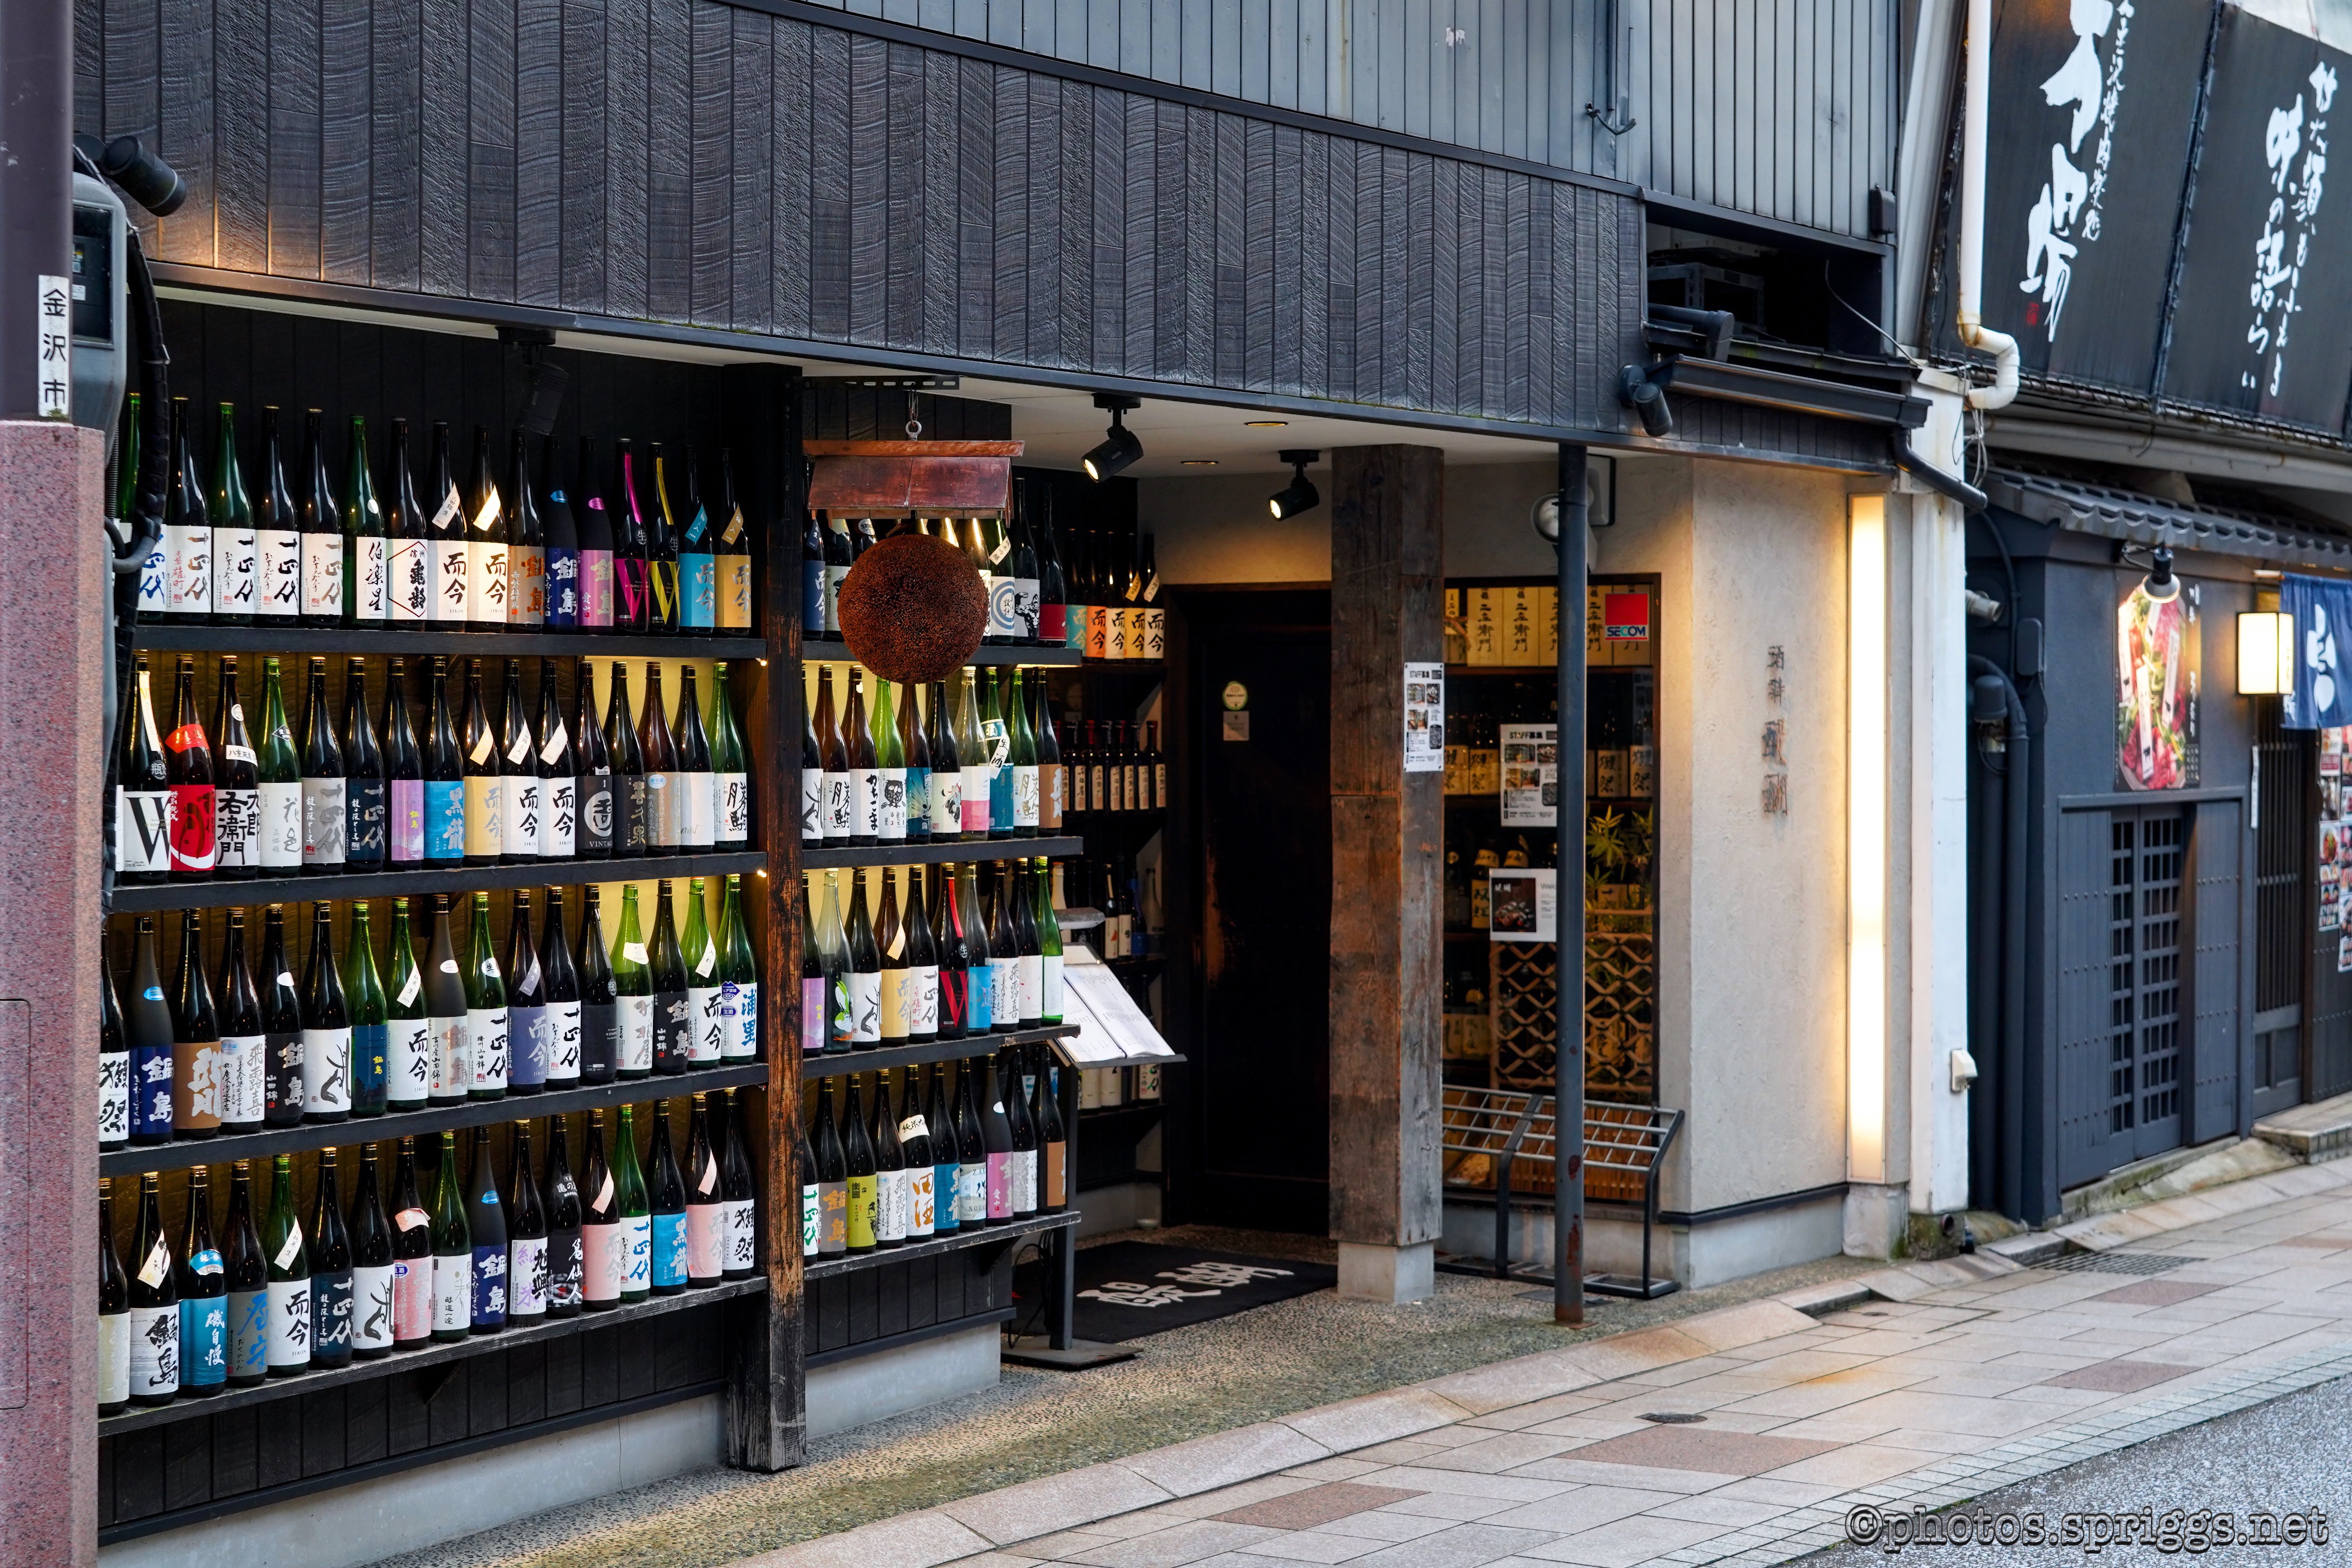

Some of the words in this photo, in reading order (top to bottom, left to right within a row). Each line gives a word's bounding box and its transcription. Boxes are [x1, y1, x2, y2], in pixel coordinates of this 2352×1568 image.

[43, 288, 67, 406] 金沢市
[409, 549, 426, 559] 信州
[637, 530, 646, 542] 生
[138, 534, 165, 600] 四代
[185, 534, 211, 607] 十四代
[234, 534, 255, 607] 十四代
[274, 535, 299, 609] 十四代
[321, 540, 343, 606] 十四代
[367, 540, 384, 612] 伯楽星
[443, 552, 466, 605] 而今
[485, 552, 506, 605] 而今
[521, 554, 544, 615] 鍋島
[551, 556, 578, 617] 鍋島
[591, 558, 612, 617] 鍋島
[614, 558, 650, 623] W
[649, 561, 680, 624] W
[696, 562, 714, 612] 而今
[732, 564, 751, 612] 而今
[1072, 608, 1086, 651] 而今
[1090, 609, 1106, 650] 而今
[1111, 610, 1125, 650] 而今
[1131, 612, 1145, 651] 而今
[1147, 613, 1164, 651] 而今
[1607, 626, 1646, 637] SECOM
[991, 738, 1009, 768] 生酒
[246, 791, 260, 851] 九郎
[284, 797, 301, 853] 花邑
[316, 784, 345, 857] 十四代
[362, 784, 385, 852] 十四代
[443, 786, 464, 850] 黒龍
[483, 786, 500, 839] 而今
[519, 786, 538, 838] 而今
[552, 786, 574, 838] 而今
[727, 781, 748, 833] 勝駒
[831, 781, 850, 829] 勝駒
[866, 773, 879, 831] かちこま
[1019, 773, 1039, 820] 勝駒
[125, 797, 170, 866] W
[217, 791, 249, 865] 右衛門
[959, 945, 968, 954] 生
[741, 988, 756, 1046] 浦里
[896, 977, 910, 1021] 而今
[921, 969, 938, 1025] 十四代
[939, 970, 968, 1029] W
[1009, 963, 1019, 1019] 飛露喜
[487, 1014, 507, 1077] 十四代
[527, 1014, 545, 1066] 而今
[560, 1007, 581, 1068] 十四代
[657, 1028, 667, 1051] 山田錦
[666, 1000, 689, 1057] 鍋島
[703, 993, 722, 1051] 而今
[246, 1042, 264, 1117] 飛露喜
[277, 1042, 304, 1107] 鍋島
[372, 1055, 383, 1075] 鍋島
[408, 1029, 428, 1084] 而今
[441, 1025, 467, 1086] 鍋島
[99, 1059, 128, 1133] 獺祭
[142, 1056, 175, 1123] 鍋島
[265, 1074, 278, 1101] 山田錦
[803, 1189, 819, 1249] 十四代
[822, 1189, 847, 1244] 鍋島
[894, 1174, 906, 1235] 飛露喜
[912, 1172, 934, 1228] 田酒
[629, 1221, 651, 1281] 十四代
[670, 1217, 687, 1277] 黒龍
[734, 1206, 754, 1262] 獺祭
[328, 1276, 354, 1346] 十四代
[444, 1296, 454, 1324] 醇道一途
[478, 1253, 506, 1314] 鍋島
[204, 1309, 225, 1367] 磯自慢
[284, 1290, 309, 1346] 而今
[144, 1312, 178, 1387] 鍋島
